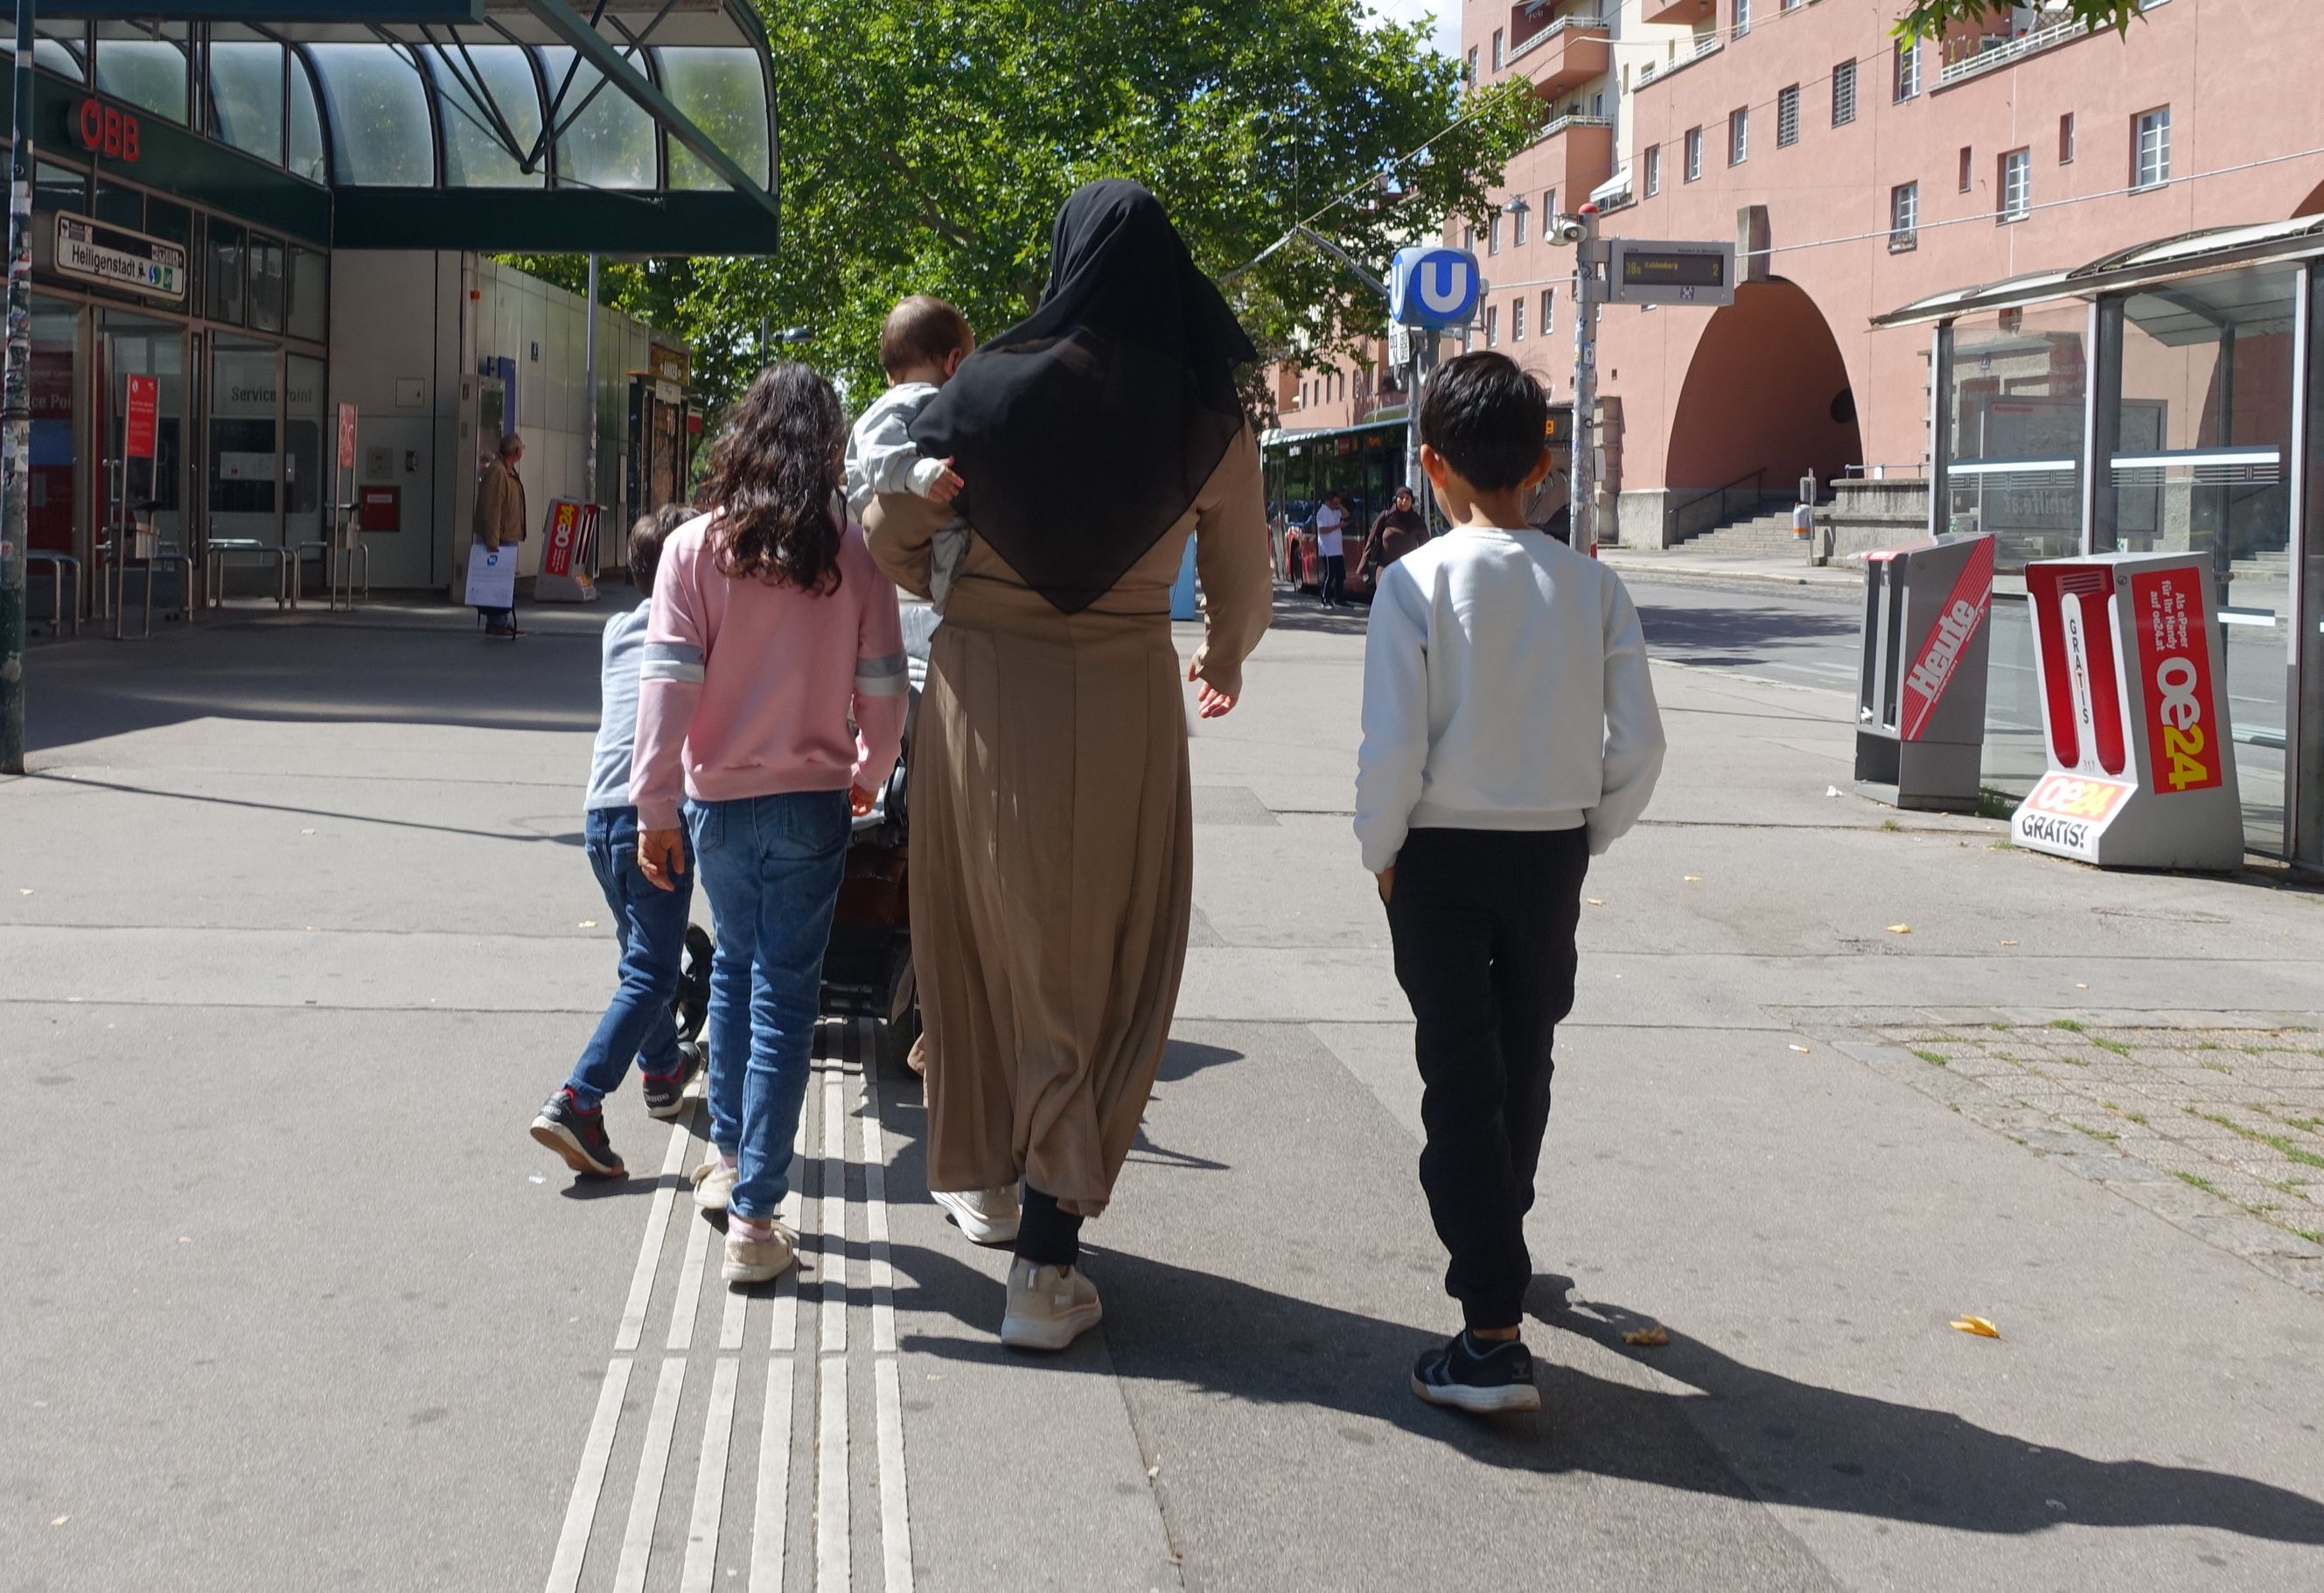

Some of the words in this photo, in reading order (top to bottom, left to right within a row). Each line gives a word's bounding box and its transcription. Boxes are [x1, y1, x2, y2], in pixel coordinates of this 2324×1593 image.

[71, 243, 136, 277] Heiligenstadt
[1712, 263, 1720, 277] 2
[1420, 262, 1467, 314] U
[231, 386, 276, 402] Service
[286, 387, 313, 403] oint
[2150, 590, 2161, 609] auf
[2161, 579, 2172, 597] für
[2175, 592, 2186, 610] Als
[2163, 598, 2174, 614] Ihr
[2153, 611, 2166, 652] oe24.at
[2166, 616, 2178, 650] Handy
[2177, 611, 2188, 648] ePaper
[1907, 599, 1975, 700] Heute
[2069, 618, 2090, 725] GRATIS
[2156, 656, 2209, 791] oe24
[2038, 778, 2117, 817] oe24
[2022, 814, 2090, 849] GRATIS!
